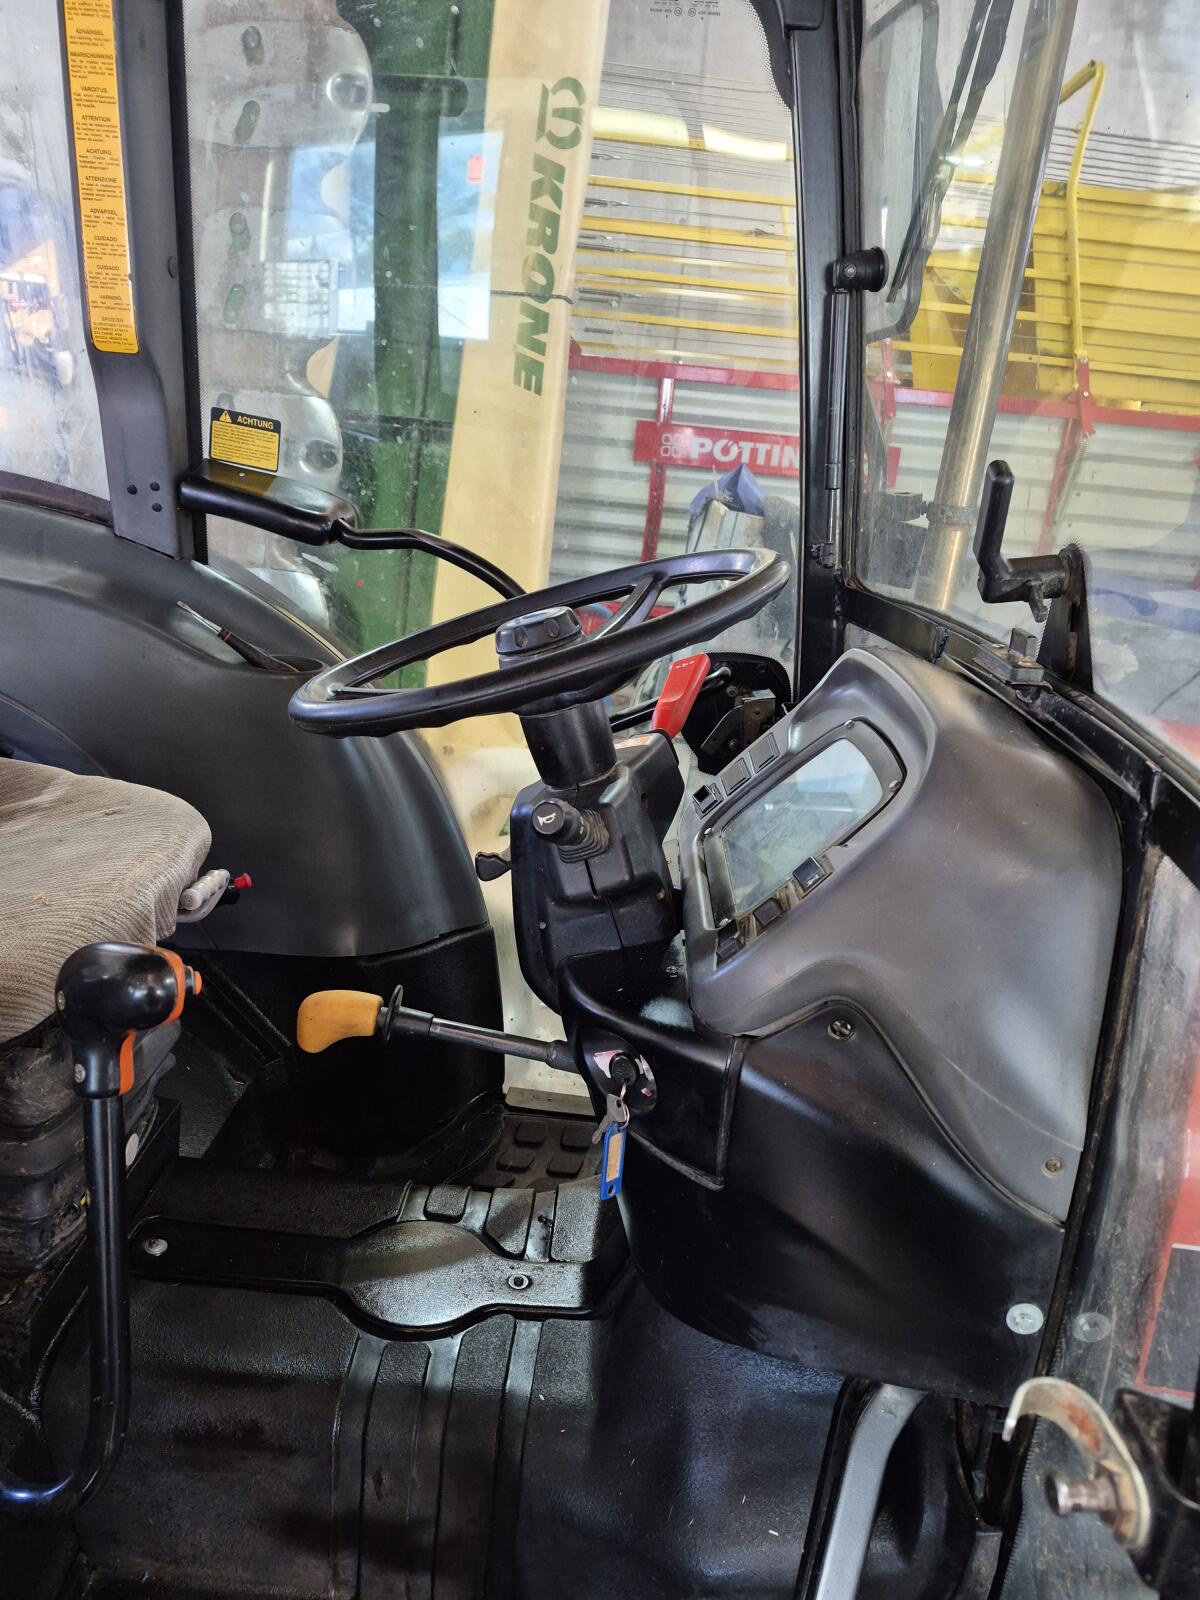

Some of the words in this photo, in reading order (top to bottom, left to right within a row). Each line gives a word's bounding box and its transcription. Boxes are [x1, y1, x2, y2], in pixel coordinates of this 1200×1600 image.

[86, 148, 112, 156] ACHTUNG
[85, 175, 118, 183] ATTENZIONE
[513, 153, 566, 397] KRONE
[237, 415, 274, 430] ACHTUNG
